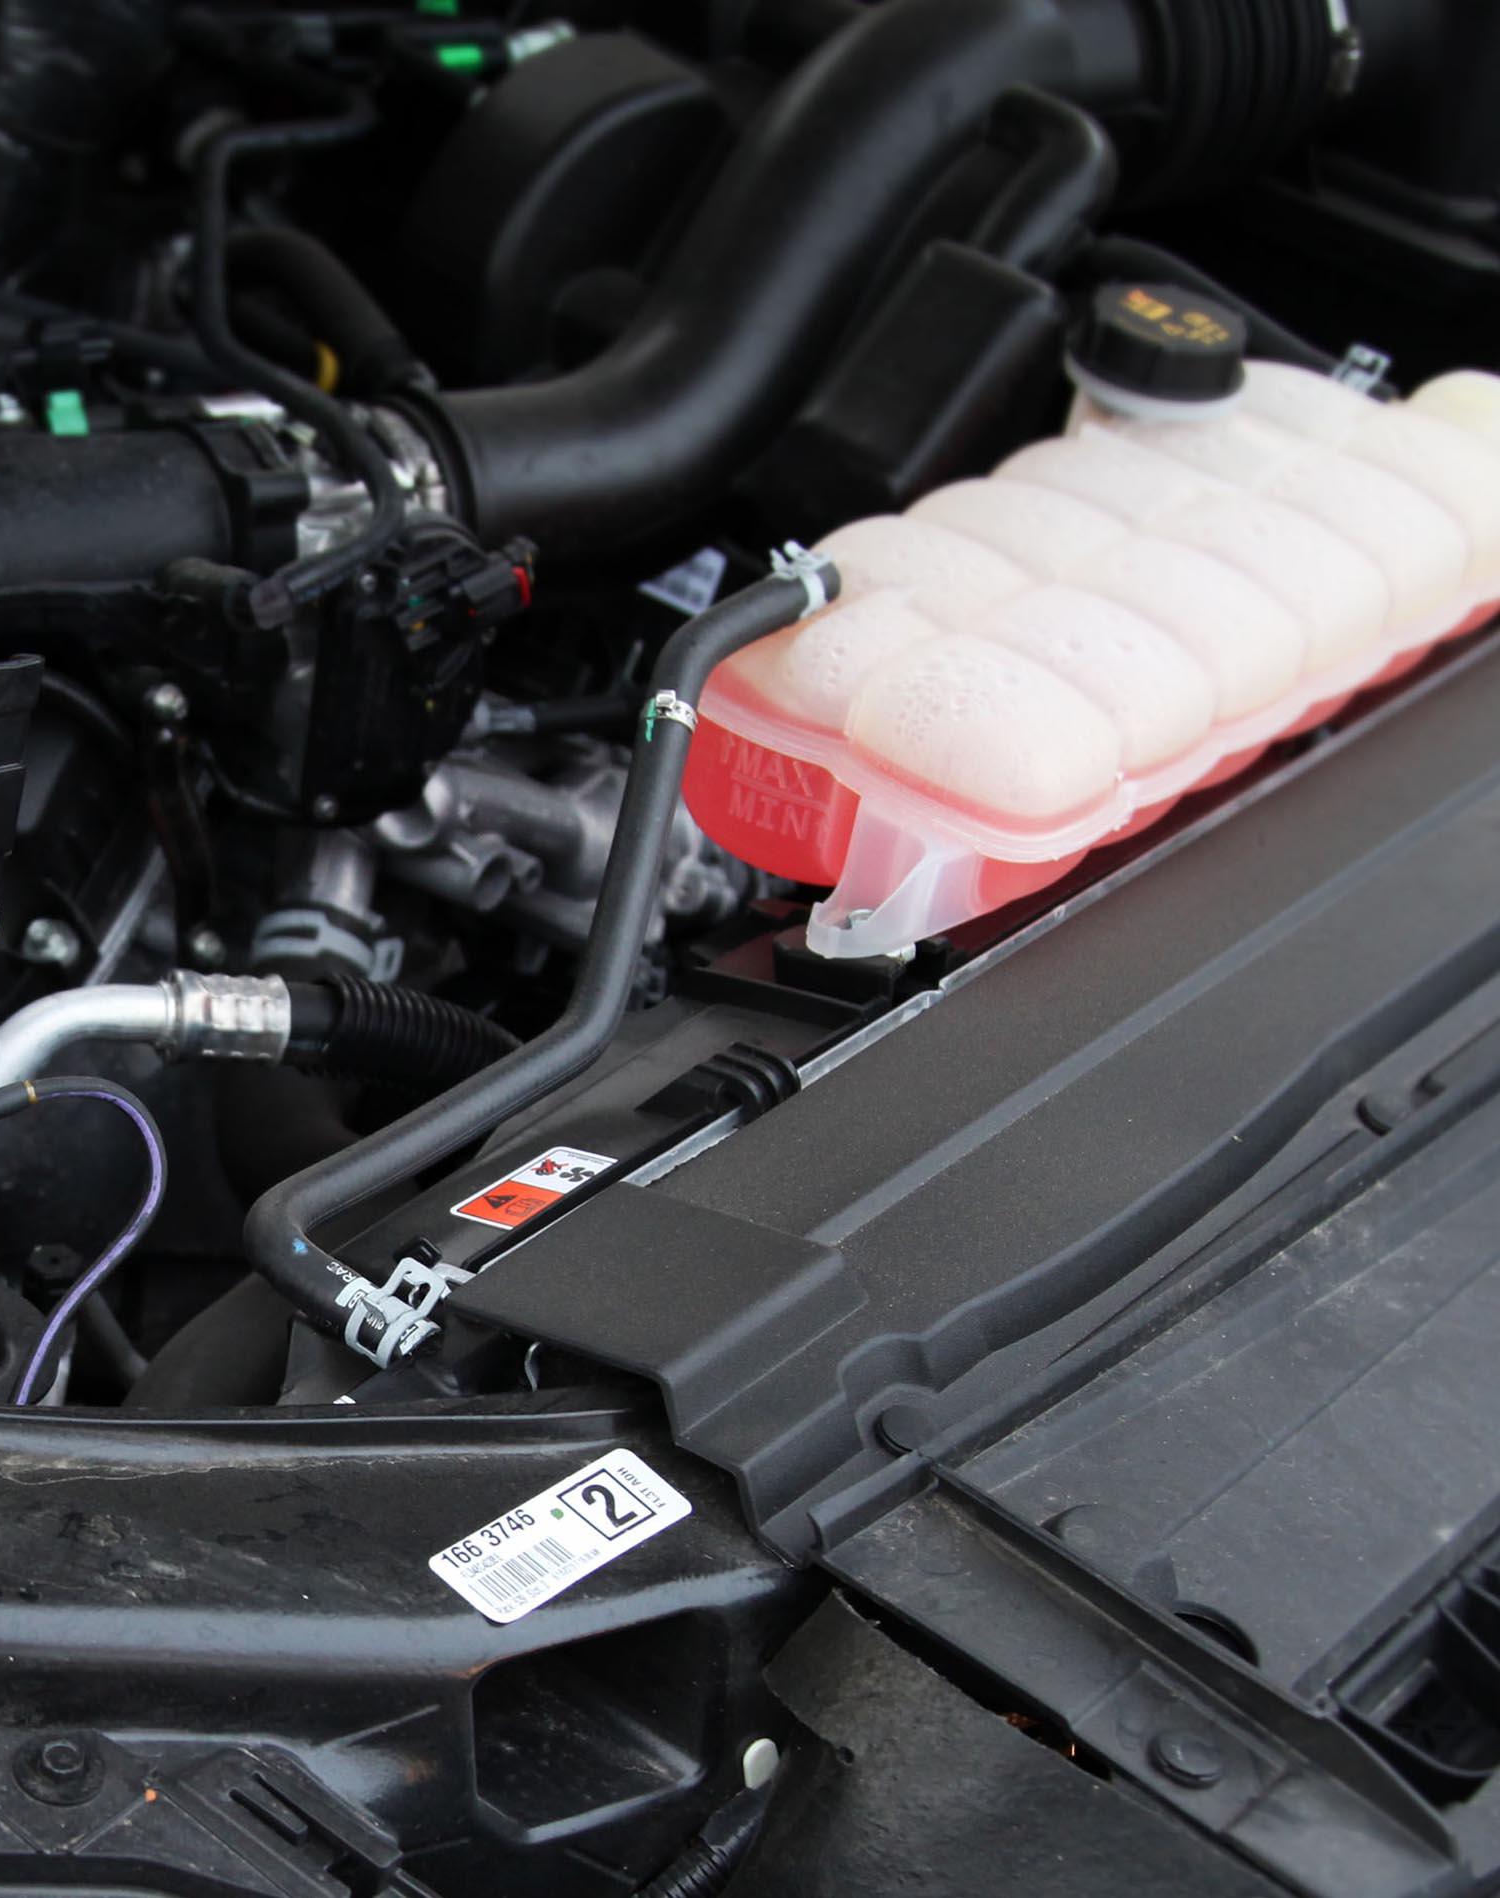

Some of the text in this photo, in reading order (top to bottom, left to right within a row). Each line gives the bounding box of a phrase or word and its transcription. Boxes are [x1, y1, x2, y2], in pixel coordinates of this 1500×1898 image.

[733, 742, 816, 798] MAX
[728, 783, 812, 840] MIN
[581, 1484, 639, 1529] 2
[441, 1540, 484, 1569] 166
[480, 1508, 536, 1547] 3746
